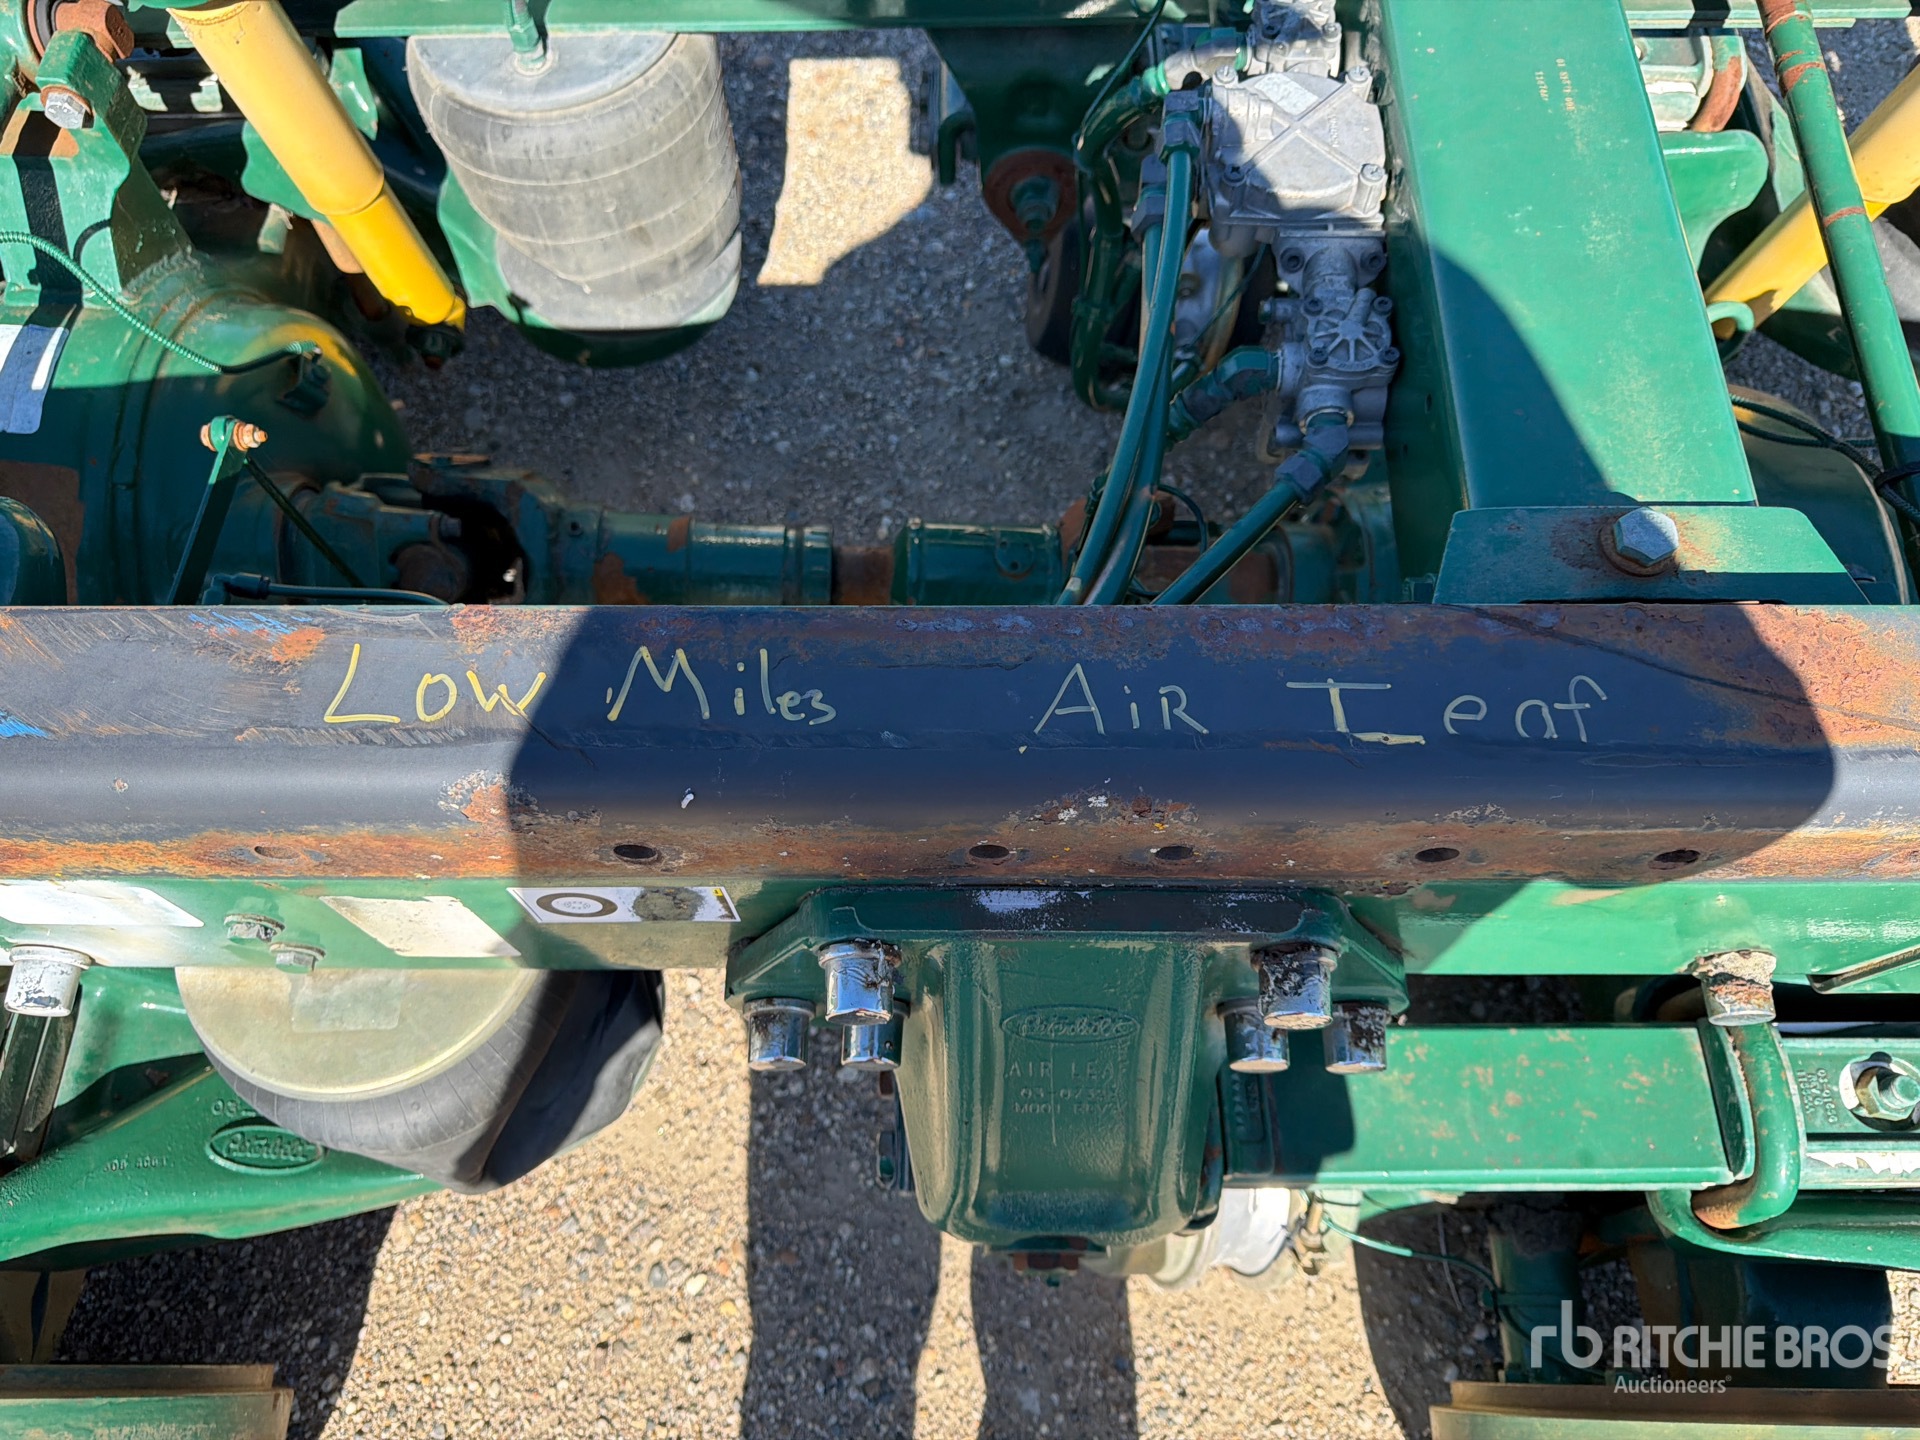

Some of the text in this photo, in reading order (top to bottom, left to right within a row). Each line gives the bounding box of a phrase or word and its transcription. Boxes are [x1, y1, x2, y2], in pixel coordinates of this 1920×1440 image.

[324, 643, 546, 724] Low
[606, 645, 838, 725] Miles
[1009, 1061, 1053, 1078] AIR
